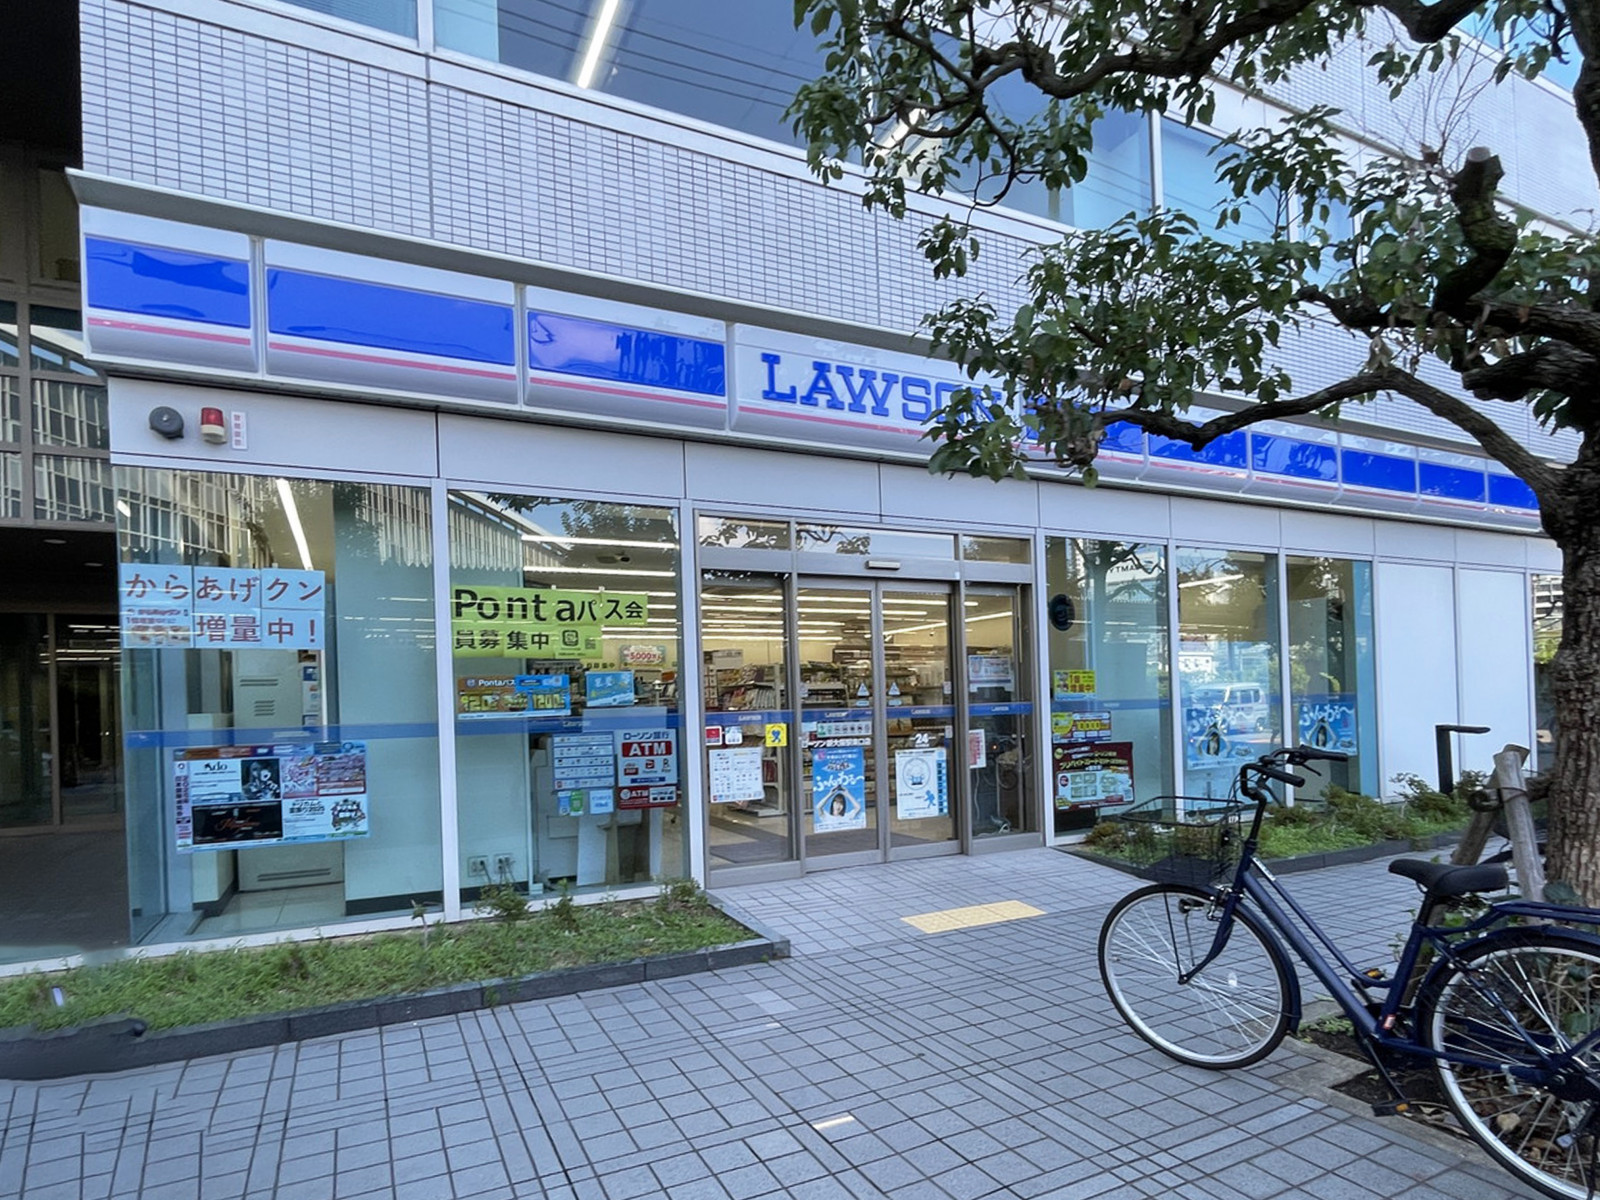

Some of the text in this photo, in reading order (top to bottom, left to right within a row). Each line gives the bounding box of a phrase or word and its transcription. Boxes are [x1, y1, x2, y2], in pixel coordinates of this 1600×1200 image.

[125, 574, 322, 603] からあげクン
[454, 589, 644, 622] Pontaパス会
[196, 615, 316, 644] 増量中！
[455, 630, 549, 650] 員募集中
[628, 742, 666, 756] ATM
